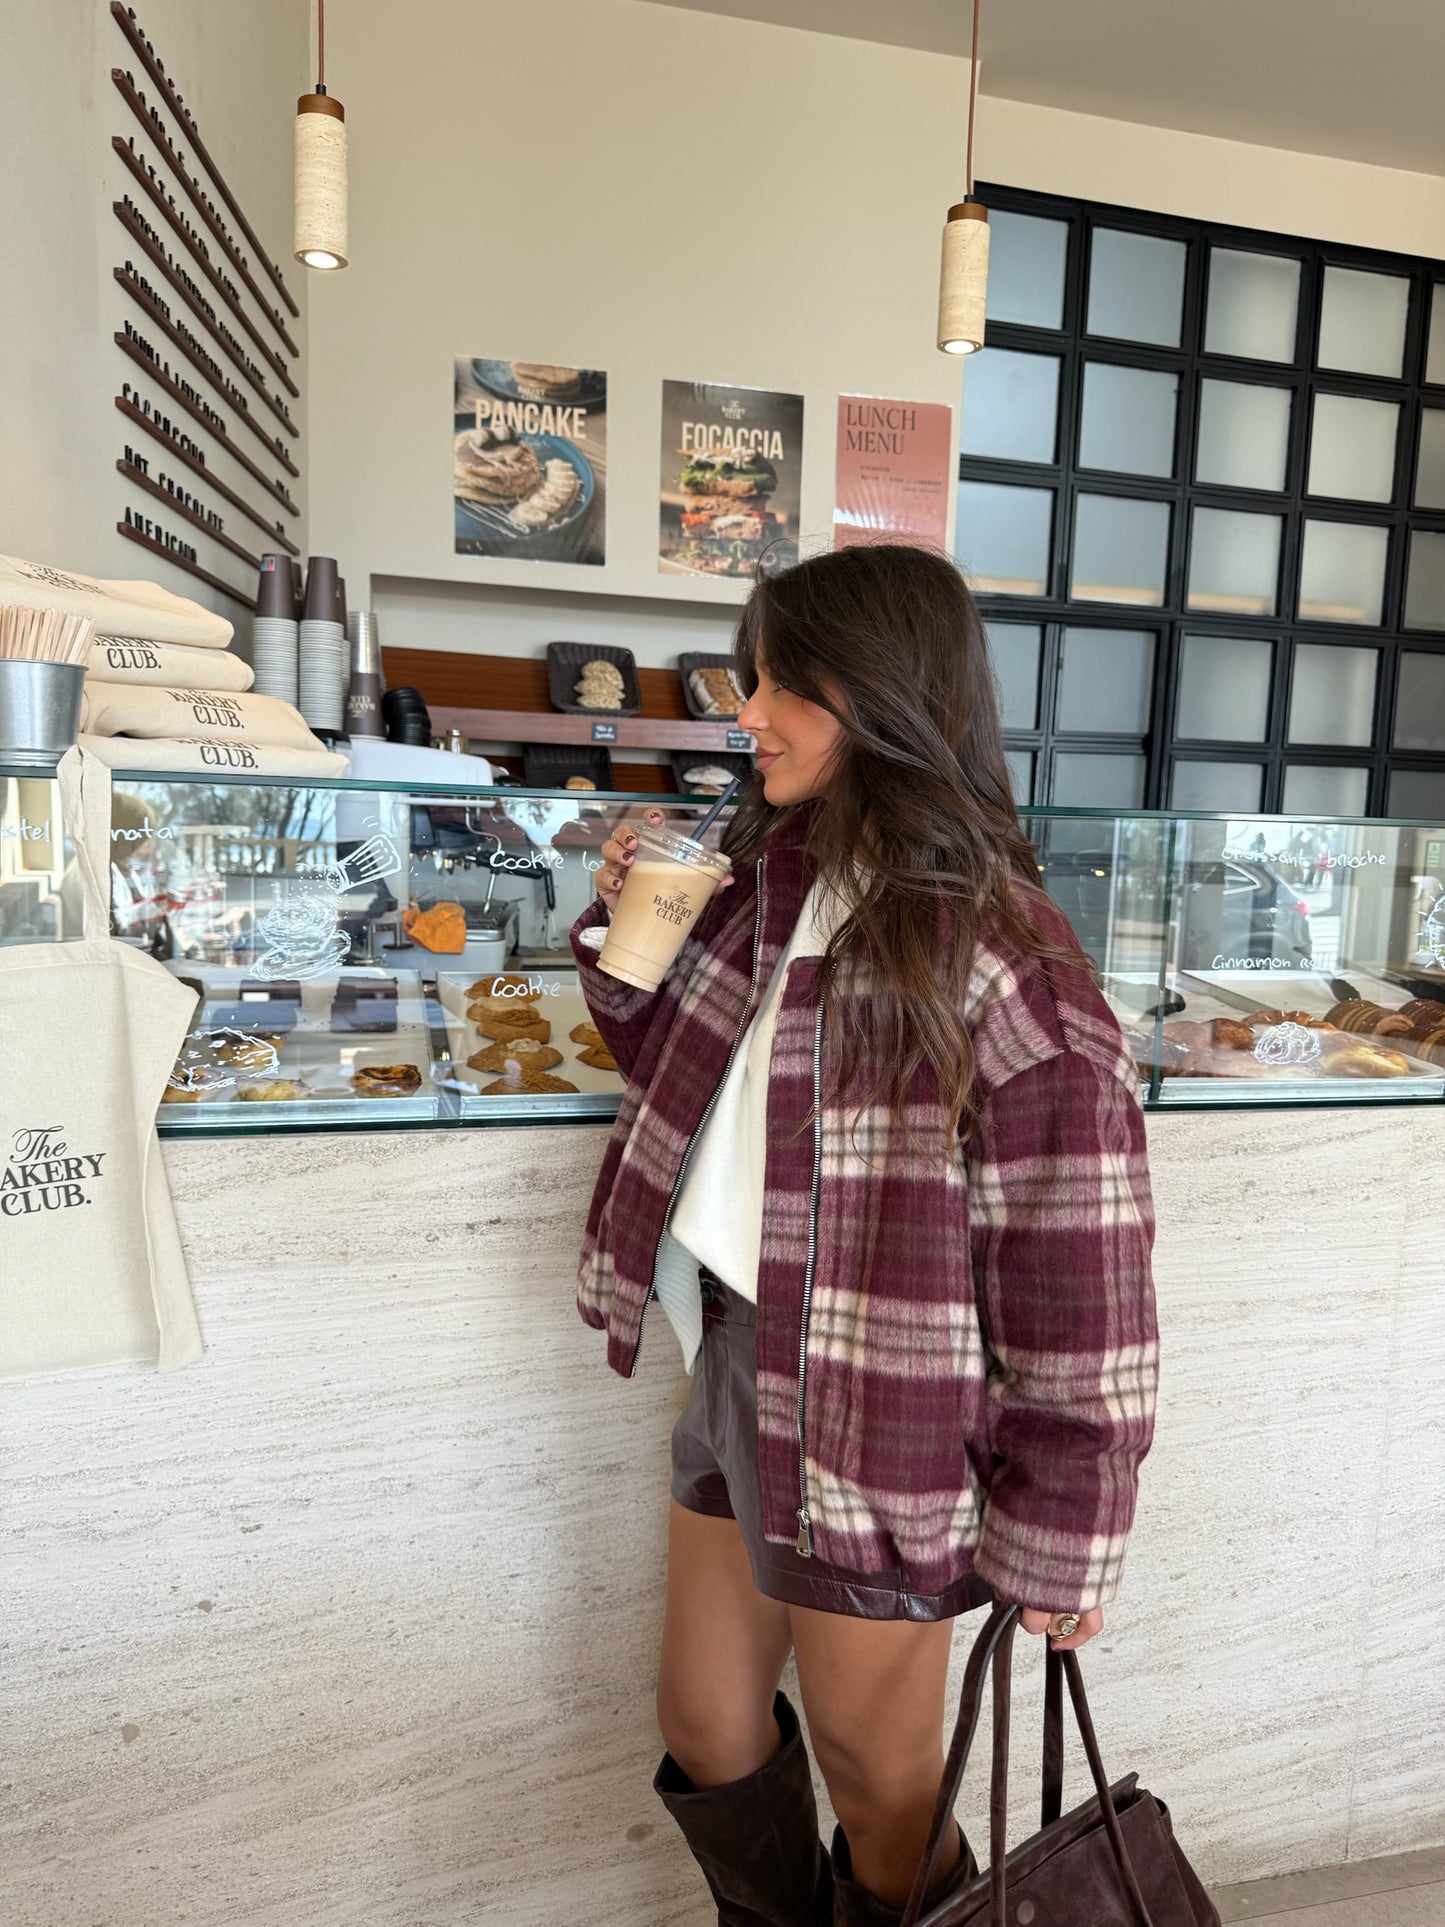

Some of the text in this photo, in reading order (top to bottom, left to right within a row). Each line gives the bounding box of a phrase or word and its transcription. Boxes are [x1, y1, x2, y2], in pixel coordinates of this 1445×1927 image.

[474, 398, 588, 439] PANCAKE
[846, 403, 916, 432] LUNCH
[680, 420, 784, 461] FOCACCIA
[845, 429, 905, 456] MENU
[124, 445, 149, 477] HOT
[158, 472, 225, 534] CHOCOLATE
[124, 506, 198, 564] AMERICANO
[107, 647, 162, 669] CLUB.
[193, 705, 245, 729] CLUB.
[200, 745, 259, 769] CLUB.
[111, 816, 174, 842] nata
[653, 894, 694, 919] BAKERY
[1211, 955, 1291, 970] Cinnamon
[10, 1125, 68, 1163] The
[1, 1184, 92, 1216] CLUB.
